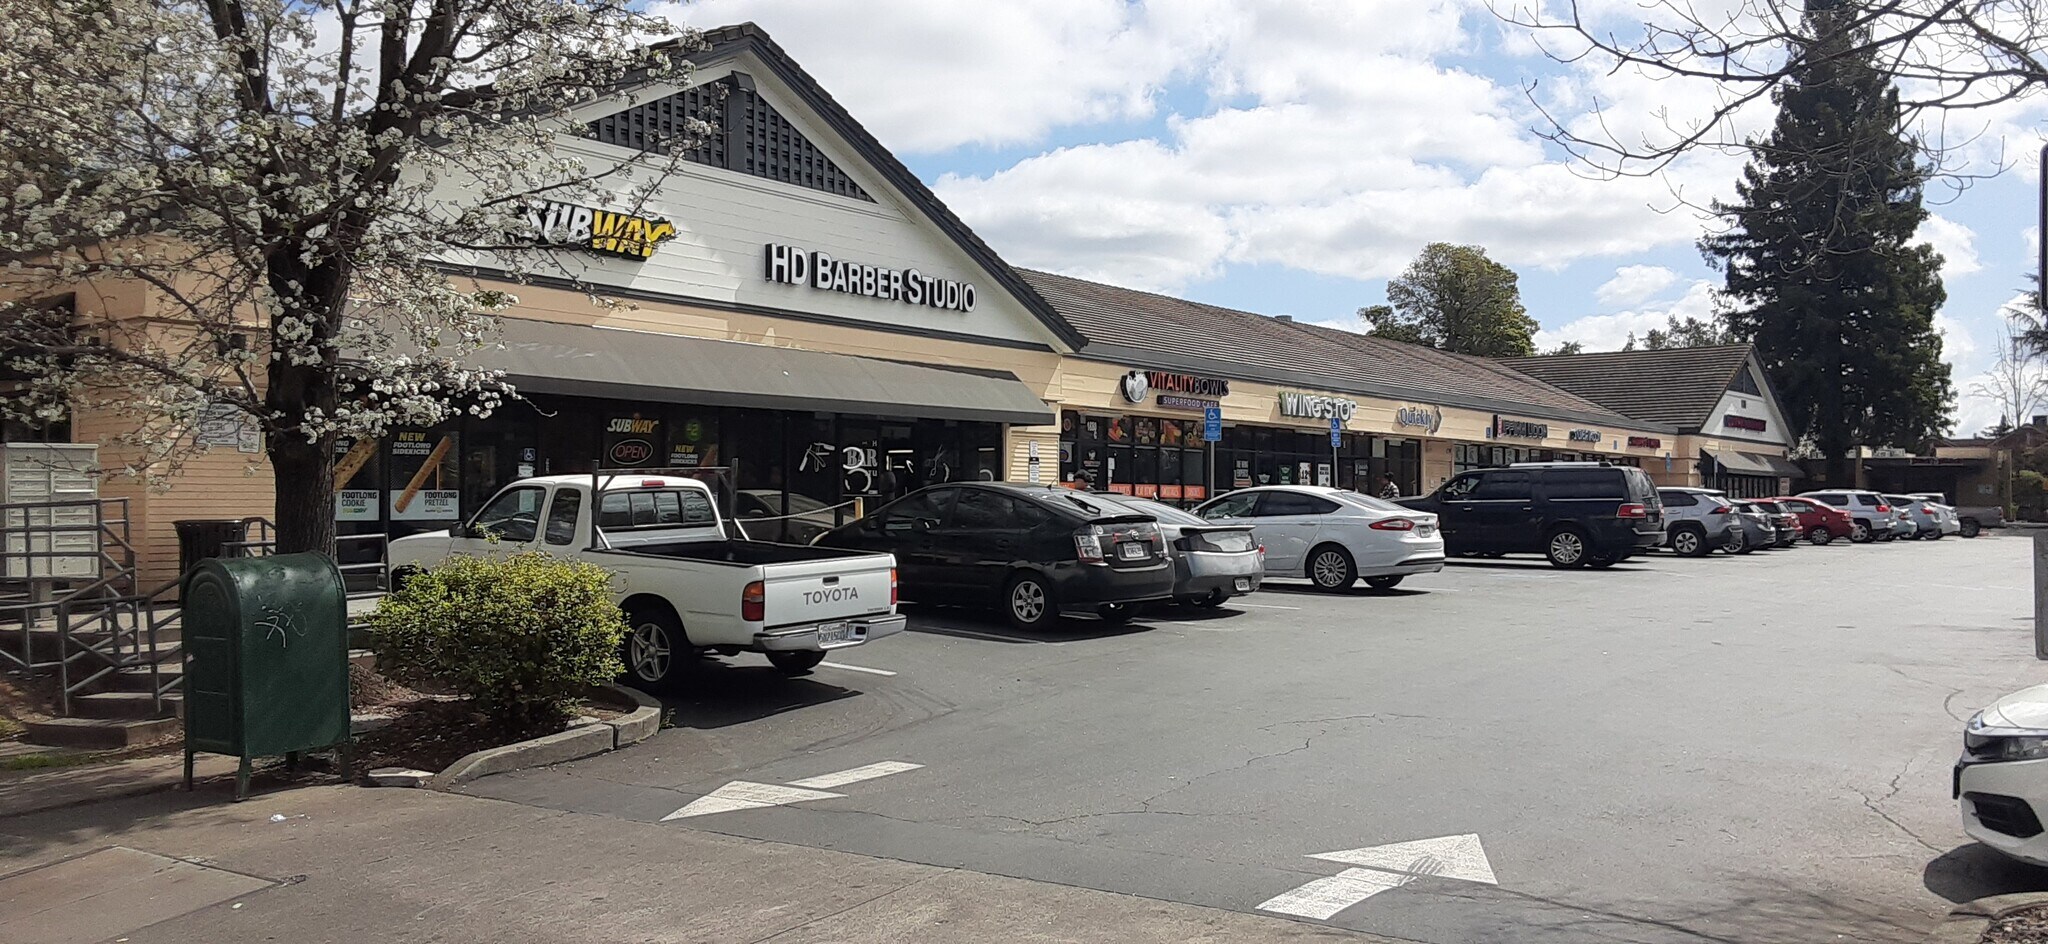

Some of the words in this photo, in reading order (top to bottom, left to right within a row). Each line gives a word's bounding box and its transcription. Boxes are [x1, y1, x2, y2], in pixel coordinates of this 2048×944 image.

[528, 200, 677, 258] SUBWAY
[768, 244, 808, 285] HD
[813, 251, 902, 301] BARBER
[903, 268, 977, 312] STUDIO
[1163, 396, 1201, 408] SUPERFOOD
[607, 418, 659, 433] SUBWAY
[399, 432, 426, 442] NEW
[615, 445, 647, 459] OPEN
[675, 444, 695, 453] NEW
[341, 491, 377, 499] FOOTLONG
[424, 491, 457, 499] FOOTLONG
[341, 499, 367, 507] COOKIE
[803, 587, 858, 605] TOYOTA
